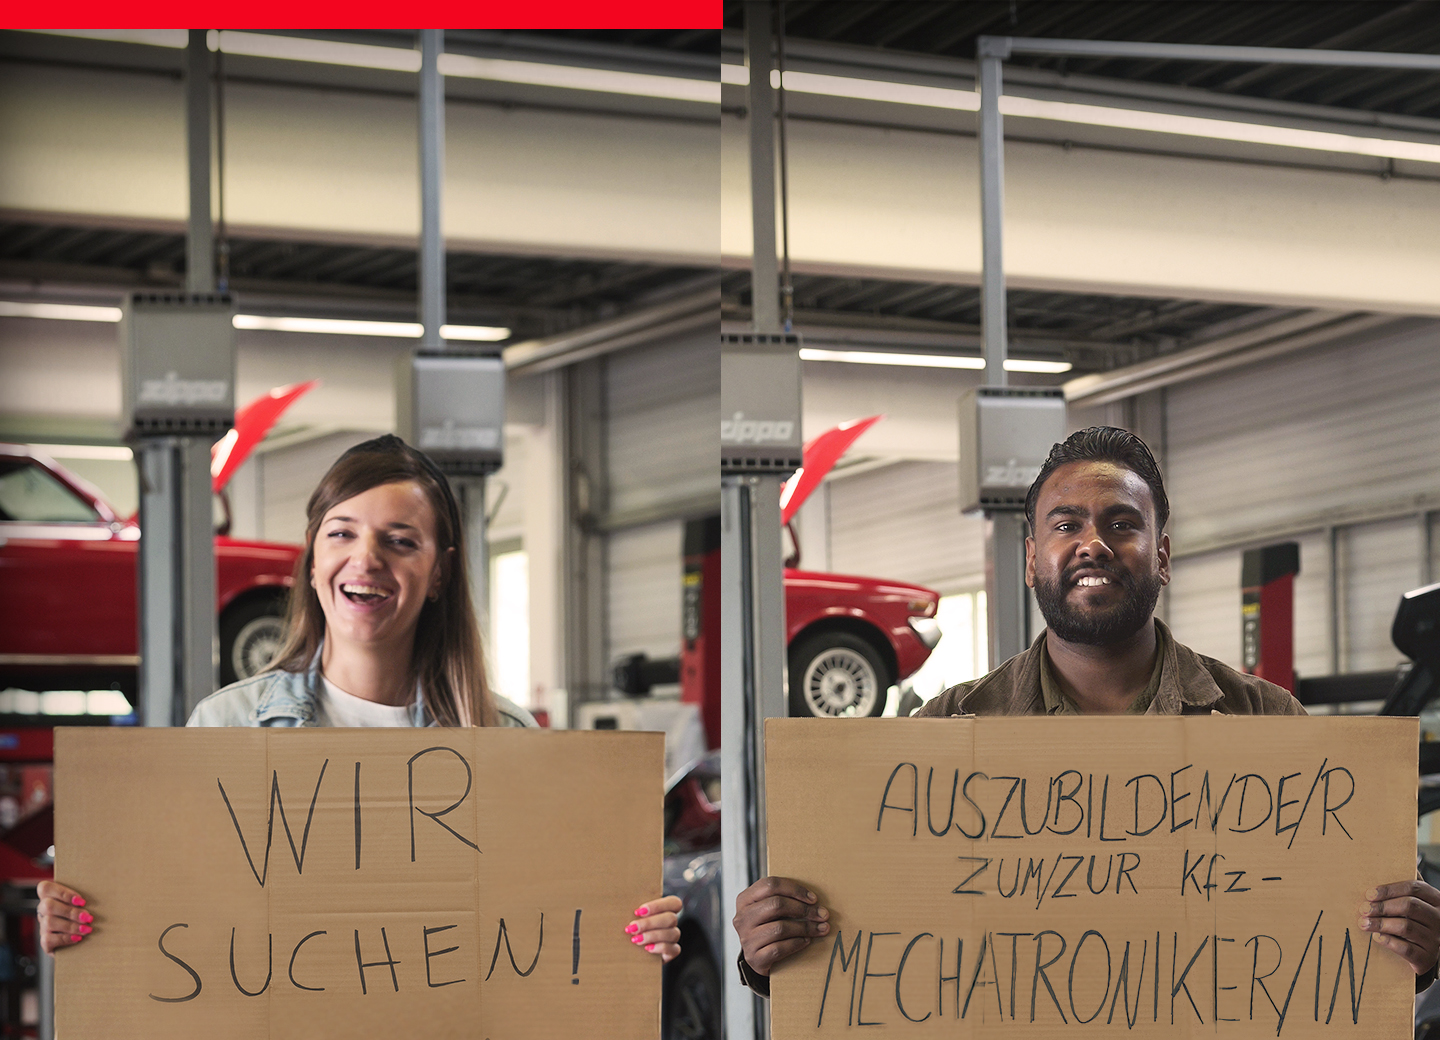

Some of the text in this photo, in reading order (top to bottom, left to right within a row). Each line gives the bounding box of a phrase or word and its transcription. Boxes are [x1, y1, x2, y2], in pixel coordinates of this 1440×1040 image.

[218, 747, 482, 888] WIR
[875, 758, 1355, 849] AUSZUBILDENDE/R
[952, 849, 1282, 910] ZUM/ZUR Kfz-
[149, 910, 581, 1003] SUCHEN!
[817, 910, 1374, 1037] MECHATRONIKER/IN
